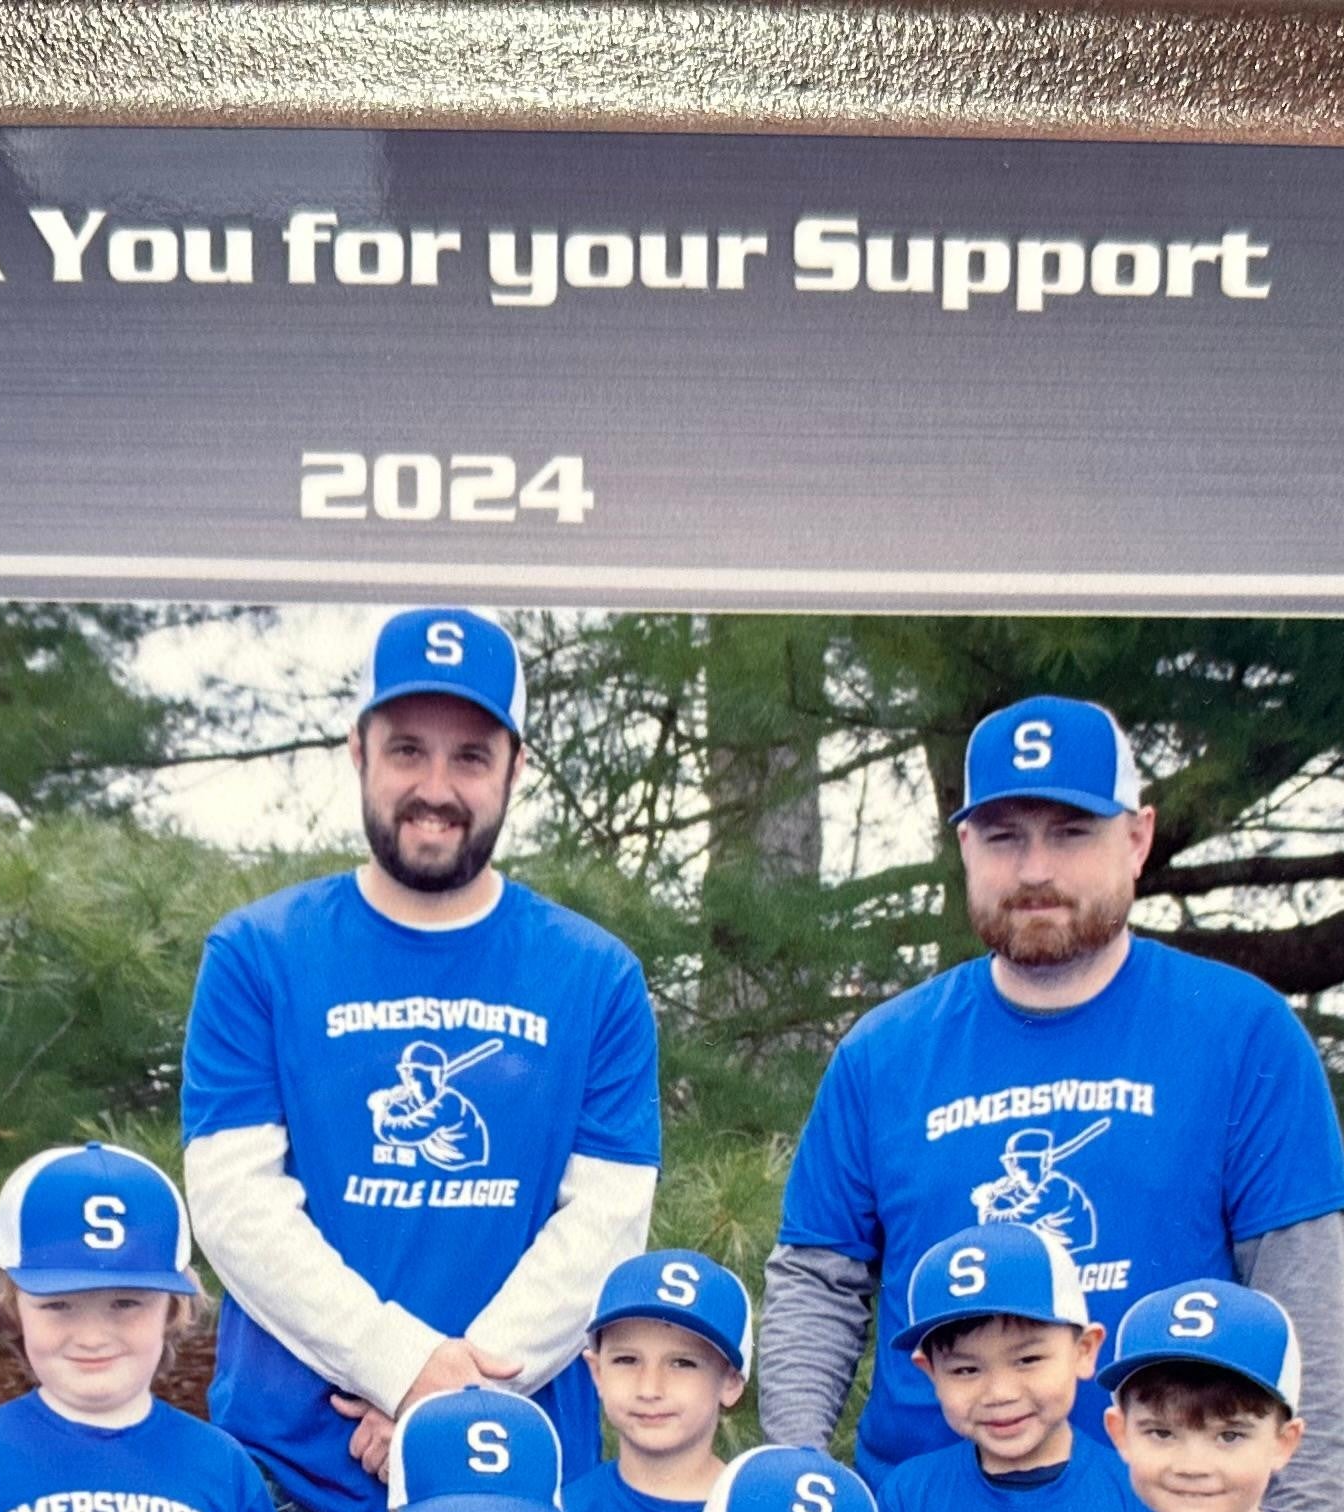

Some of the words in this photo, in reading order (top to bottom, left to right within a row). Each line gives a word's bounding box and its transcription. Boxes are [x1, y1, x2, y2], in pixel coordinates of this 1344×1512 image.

[29, 209, 253, 285] You
[282, 211, 461, 287] for
[488, 232, 768, 307] your
[792, 218, 1272, 312] Support
[299, 452, 595, 525] 2024
[426, 620, 465, 666] S
[1013, 720, 1053, 771] S
[327, 996, 548, 1048] SOMERSWORTH
[925, 1078, 1155, 1142] SOMERSWORTH
[343, 1174, 426, 1209] LITTLE
[428, 1178, 520, 1207] LEAGUE
[84, 1195, 127, 1251] S
[656, 1260, 701, 1308] S
[948, 1246, 987, 1298] S
[1168, 1290, 1220, 1339] S
[467, 1420, 511, 1474] S
